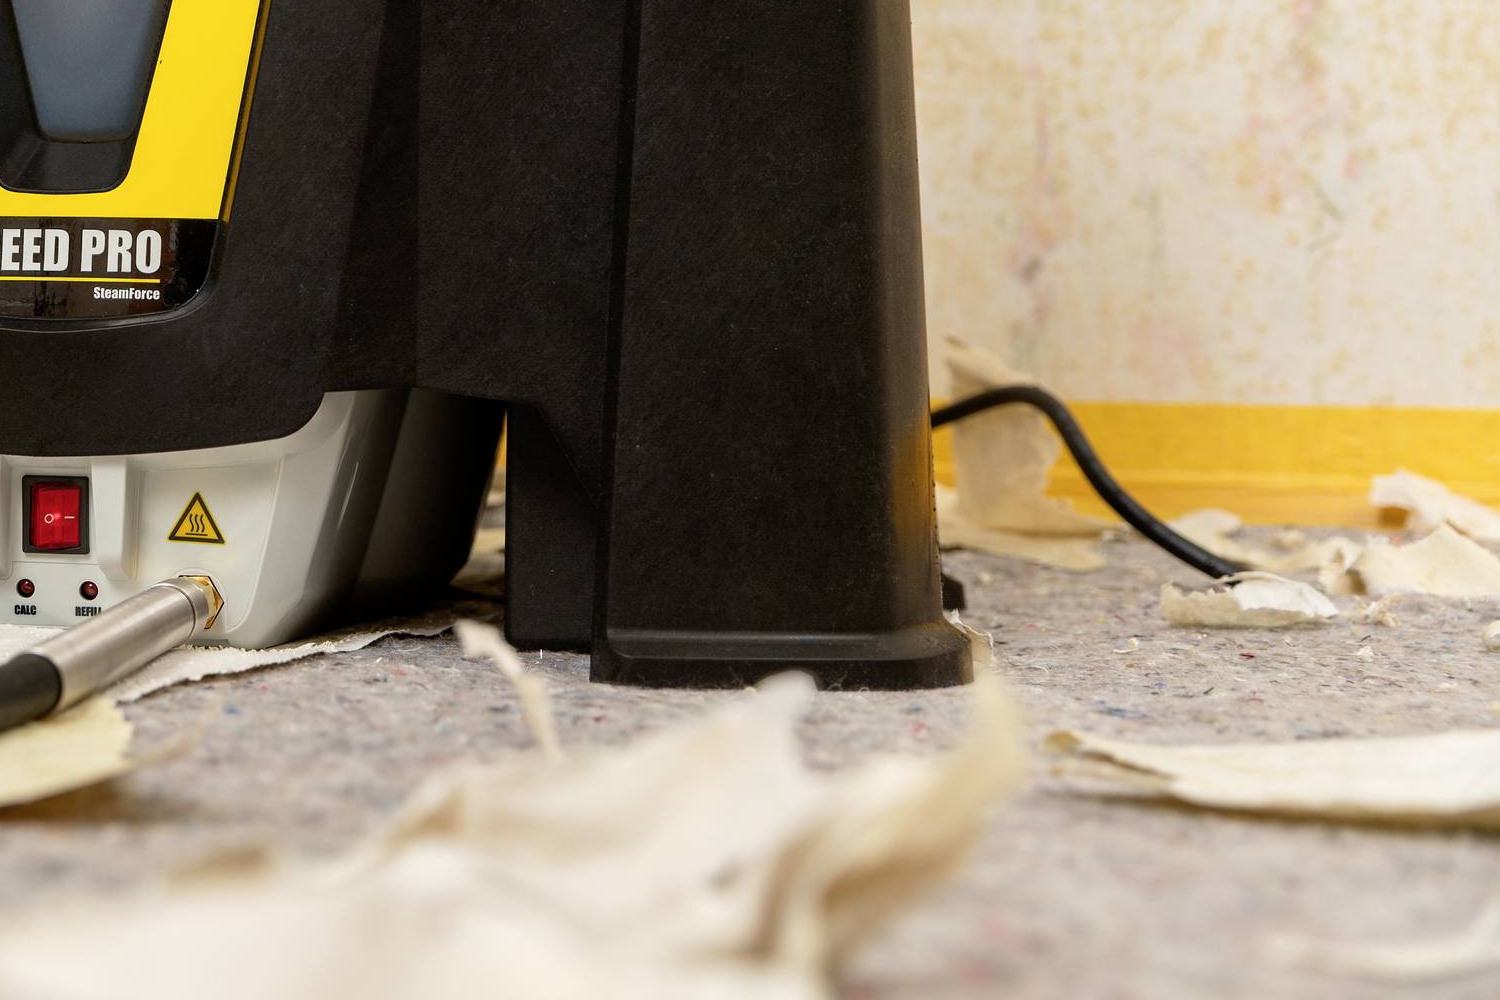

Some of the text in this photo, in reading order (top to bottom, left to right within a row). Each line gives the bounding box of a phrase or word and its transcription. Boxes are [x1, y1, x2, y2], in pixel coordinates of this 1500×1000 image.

[80, 229, 162, 274] PRO
[93, 286, 161, 301] SteamForce
[14, 604, 37, 616] CALC
